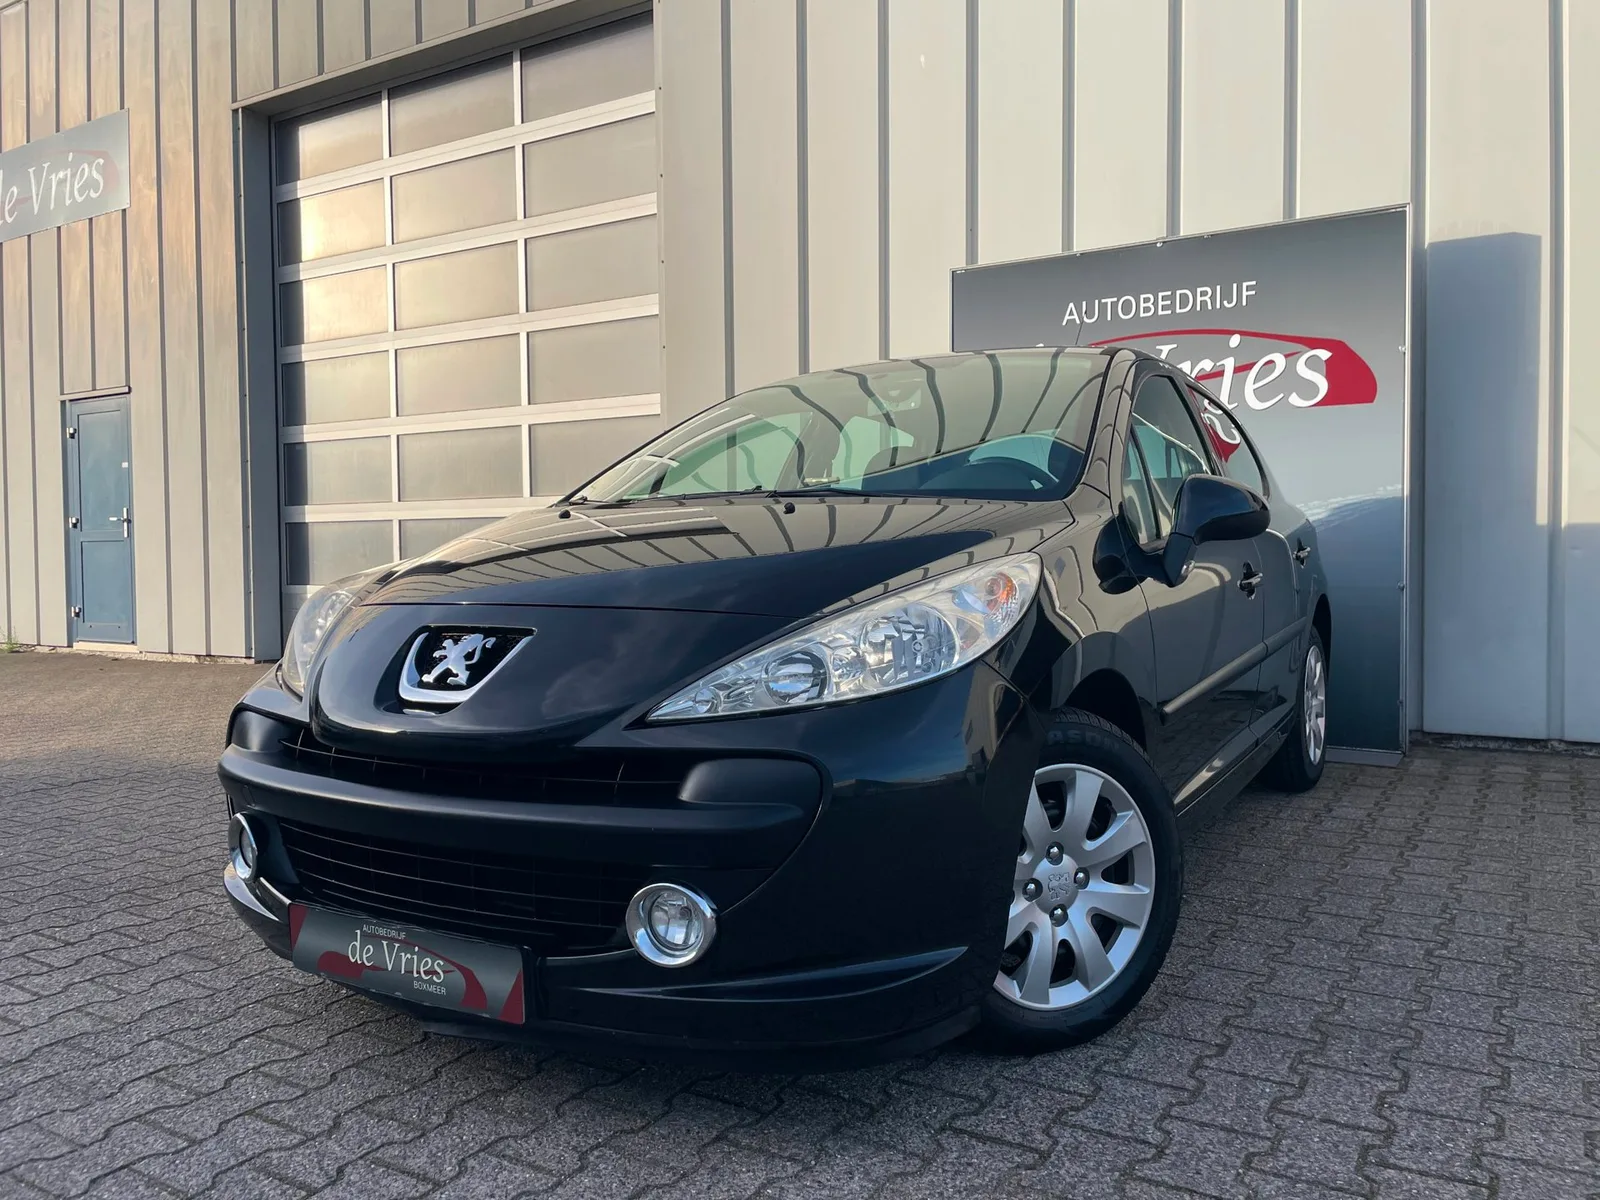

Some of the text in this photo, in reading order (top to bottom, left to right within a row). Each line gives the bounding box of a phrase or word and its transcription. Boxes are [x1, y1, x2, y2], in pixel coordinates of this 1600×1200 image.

[27, 152, 104, 215] Vries
[1062, 280, 1257, 326] AUTOBEDRIJF
[1155, 334, 1332, 415] ries
[348, 929, 444, 983] de Vries
[362, 924, 407, 940] AUTOBEDRIJF
[413, 980, 447, 996] BOXMEER
